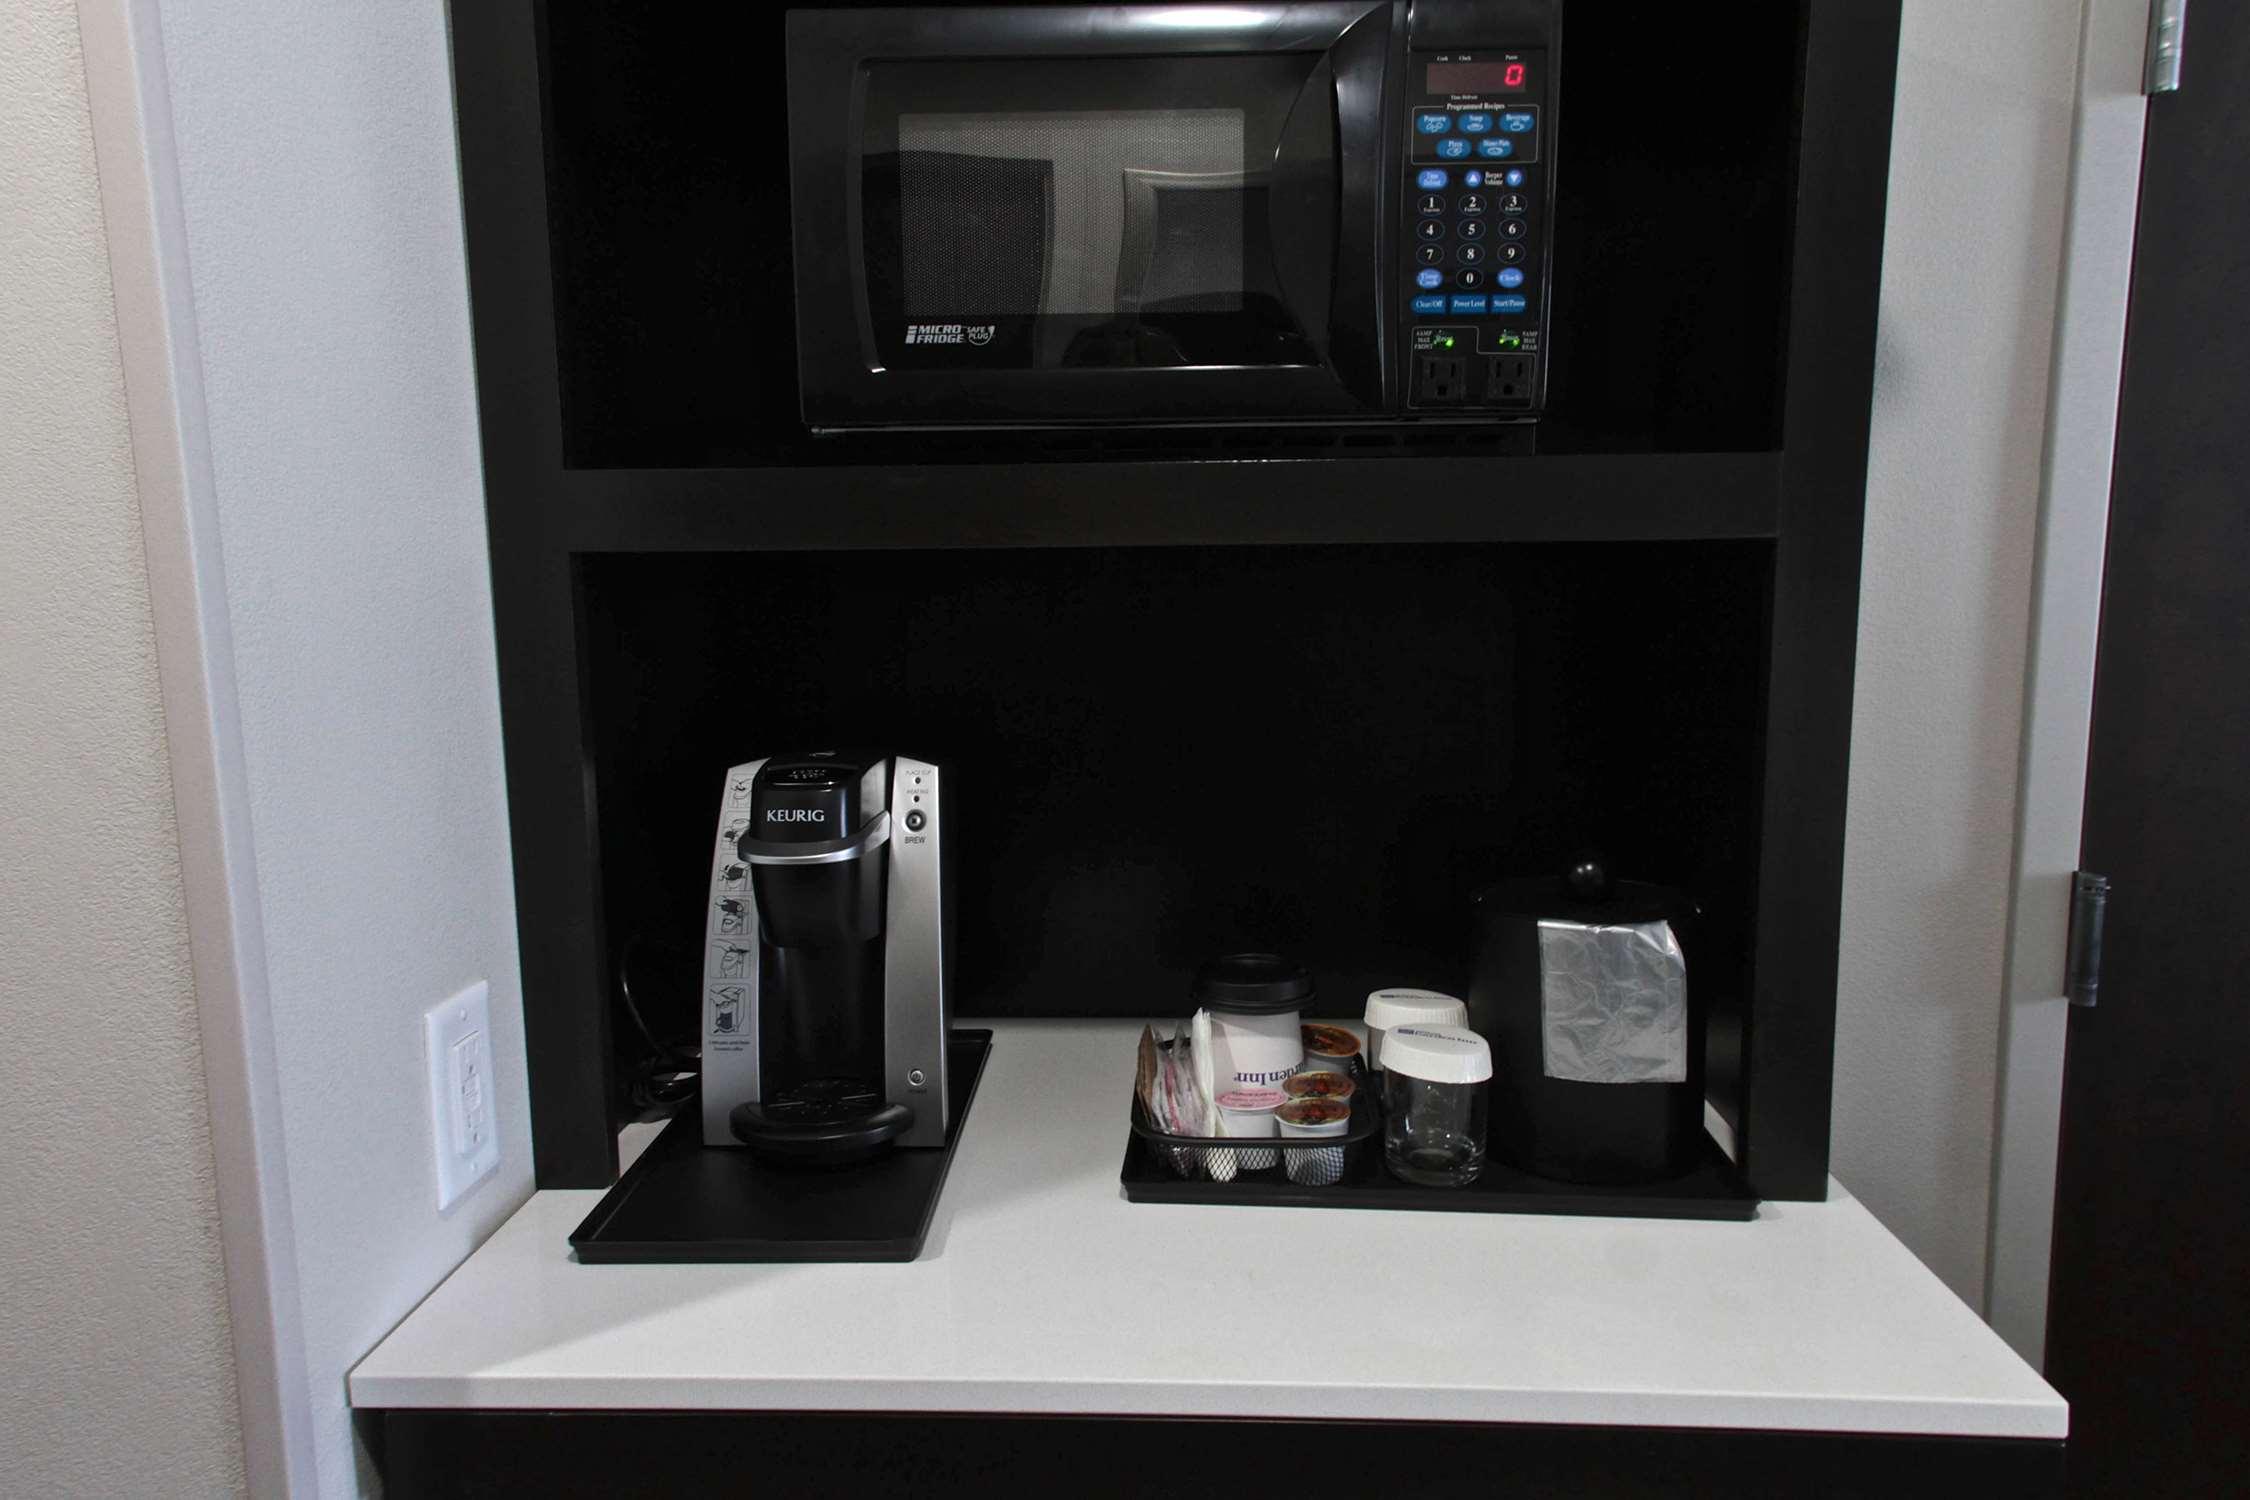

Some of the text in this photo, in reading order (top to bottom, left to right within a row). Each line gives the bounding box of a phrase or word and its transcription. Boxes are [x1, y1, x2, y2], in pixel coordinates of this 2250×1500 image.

[1504, 63, 1524, 86] 0
[1446, 102, 1505, 111] Programmed Recipes
[1429, 196, 1435, 208] 1
[1469, 196, 1477, 208] 2
[1509, 195, 1518, 207] 3
[1426, 224, 1434, 236] 4
[1467, 223, 1476, 236] 5
[1508, 223, 1517, 234] 6
[1426, 248, 1434, 260] 7
[1466, 248, 1475, 260] 8
[1507, 247, 1515, 259] 9
[1466, 272, 1474, 284] 0
[1470, 300, 1486, 308] Level
[918, 325, 961, 334] MICRO
[916, 334, 964, 344] FRIDGE
[766, 809, 825, 822] KEURIG
[904, 835, 926, 844] BREW
[1237, 1072, 1266, 1085] Inn
